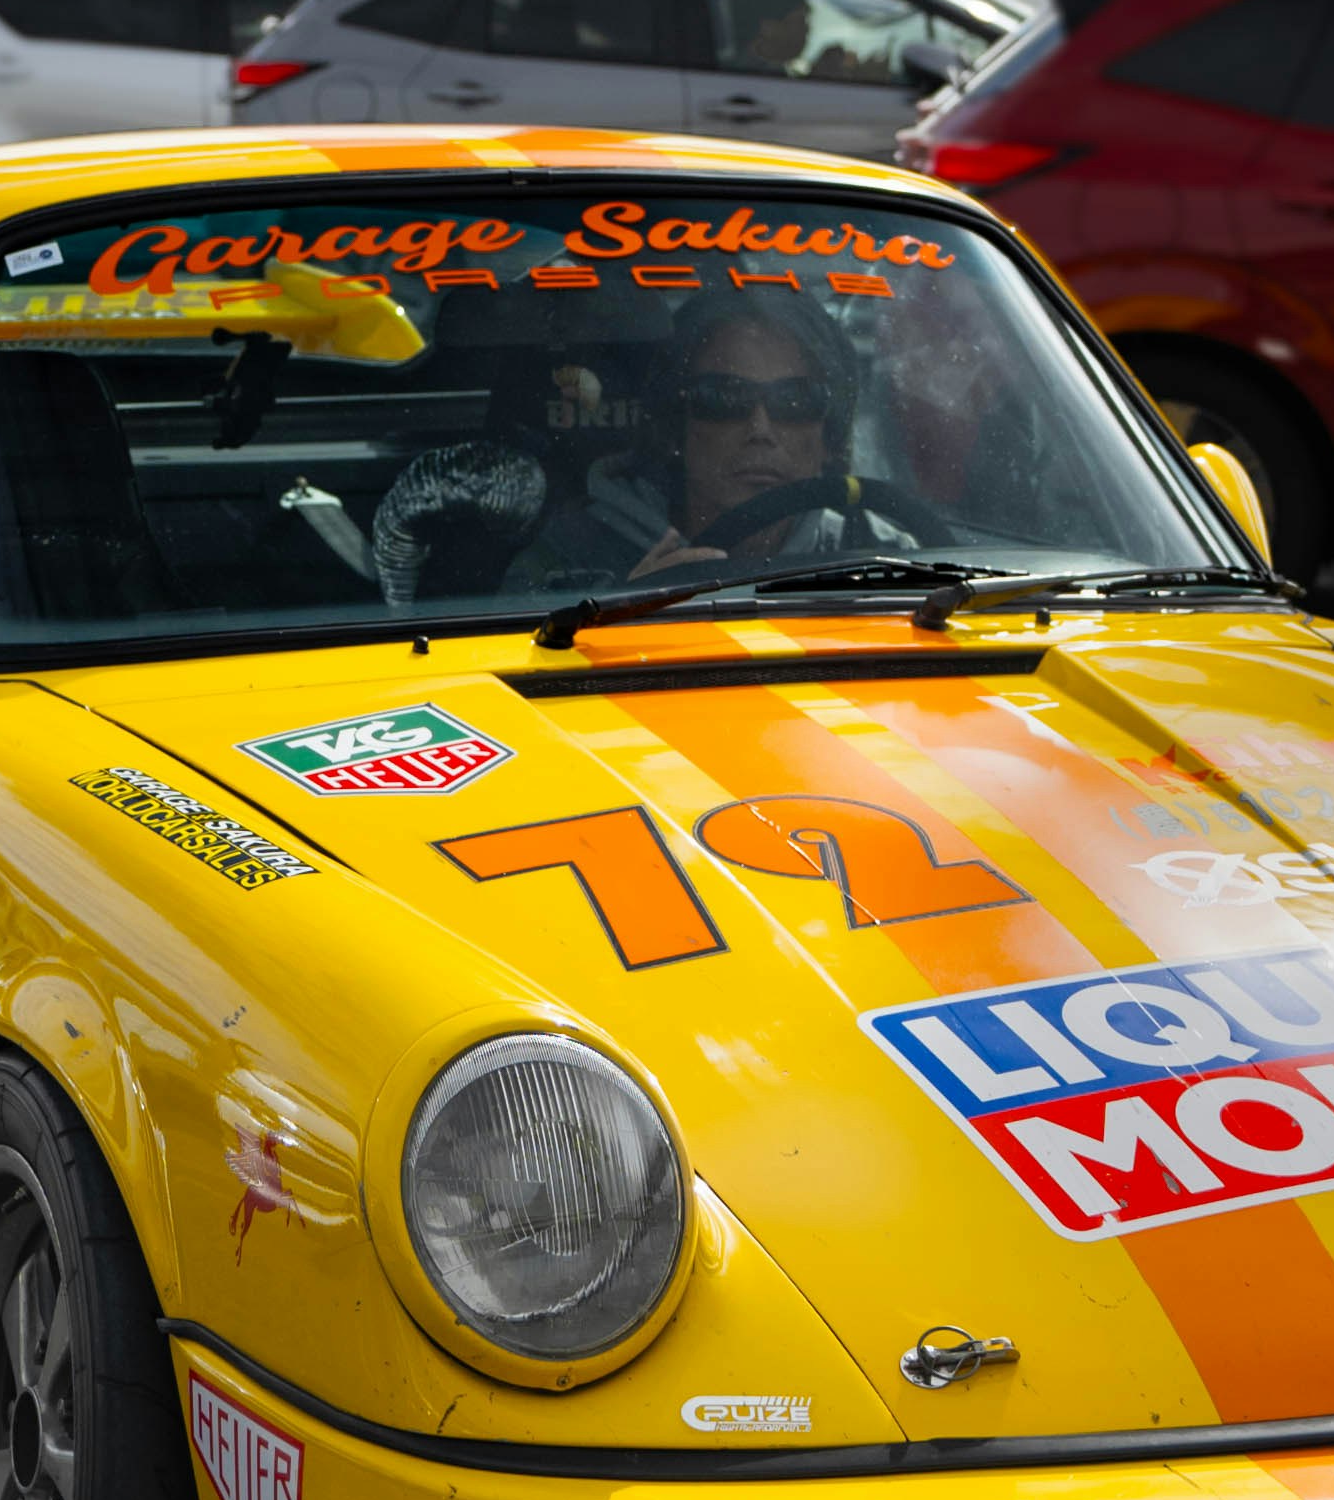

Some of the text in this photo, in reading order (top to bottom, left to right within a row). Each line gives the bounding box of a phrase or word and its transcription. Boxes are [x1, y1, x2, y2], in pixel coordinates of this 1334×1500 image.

[89, 201, 955, 297] Garage Sakura
[209, 264, 895, 311] PORSCHE
[285, 719, 433, 764] TAG
[317, 743, 491, 788] HEUER
[72, 769, 278, 889] WORLDCARSALES
[108, 767, 317, 878] GARAGE SAKURA
[427, 794, 1037, 972] 72
[680, 1395, 812, 1432] CRUIZE
